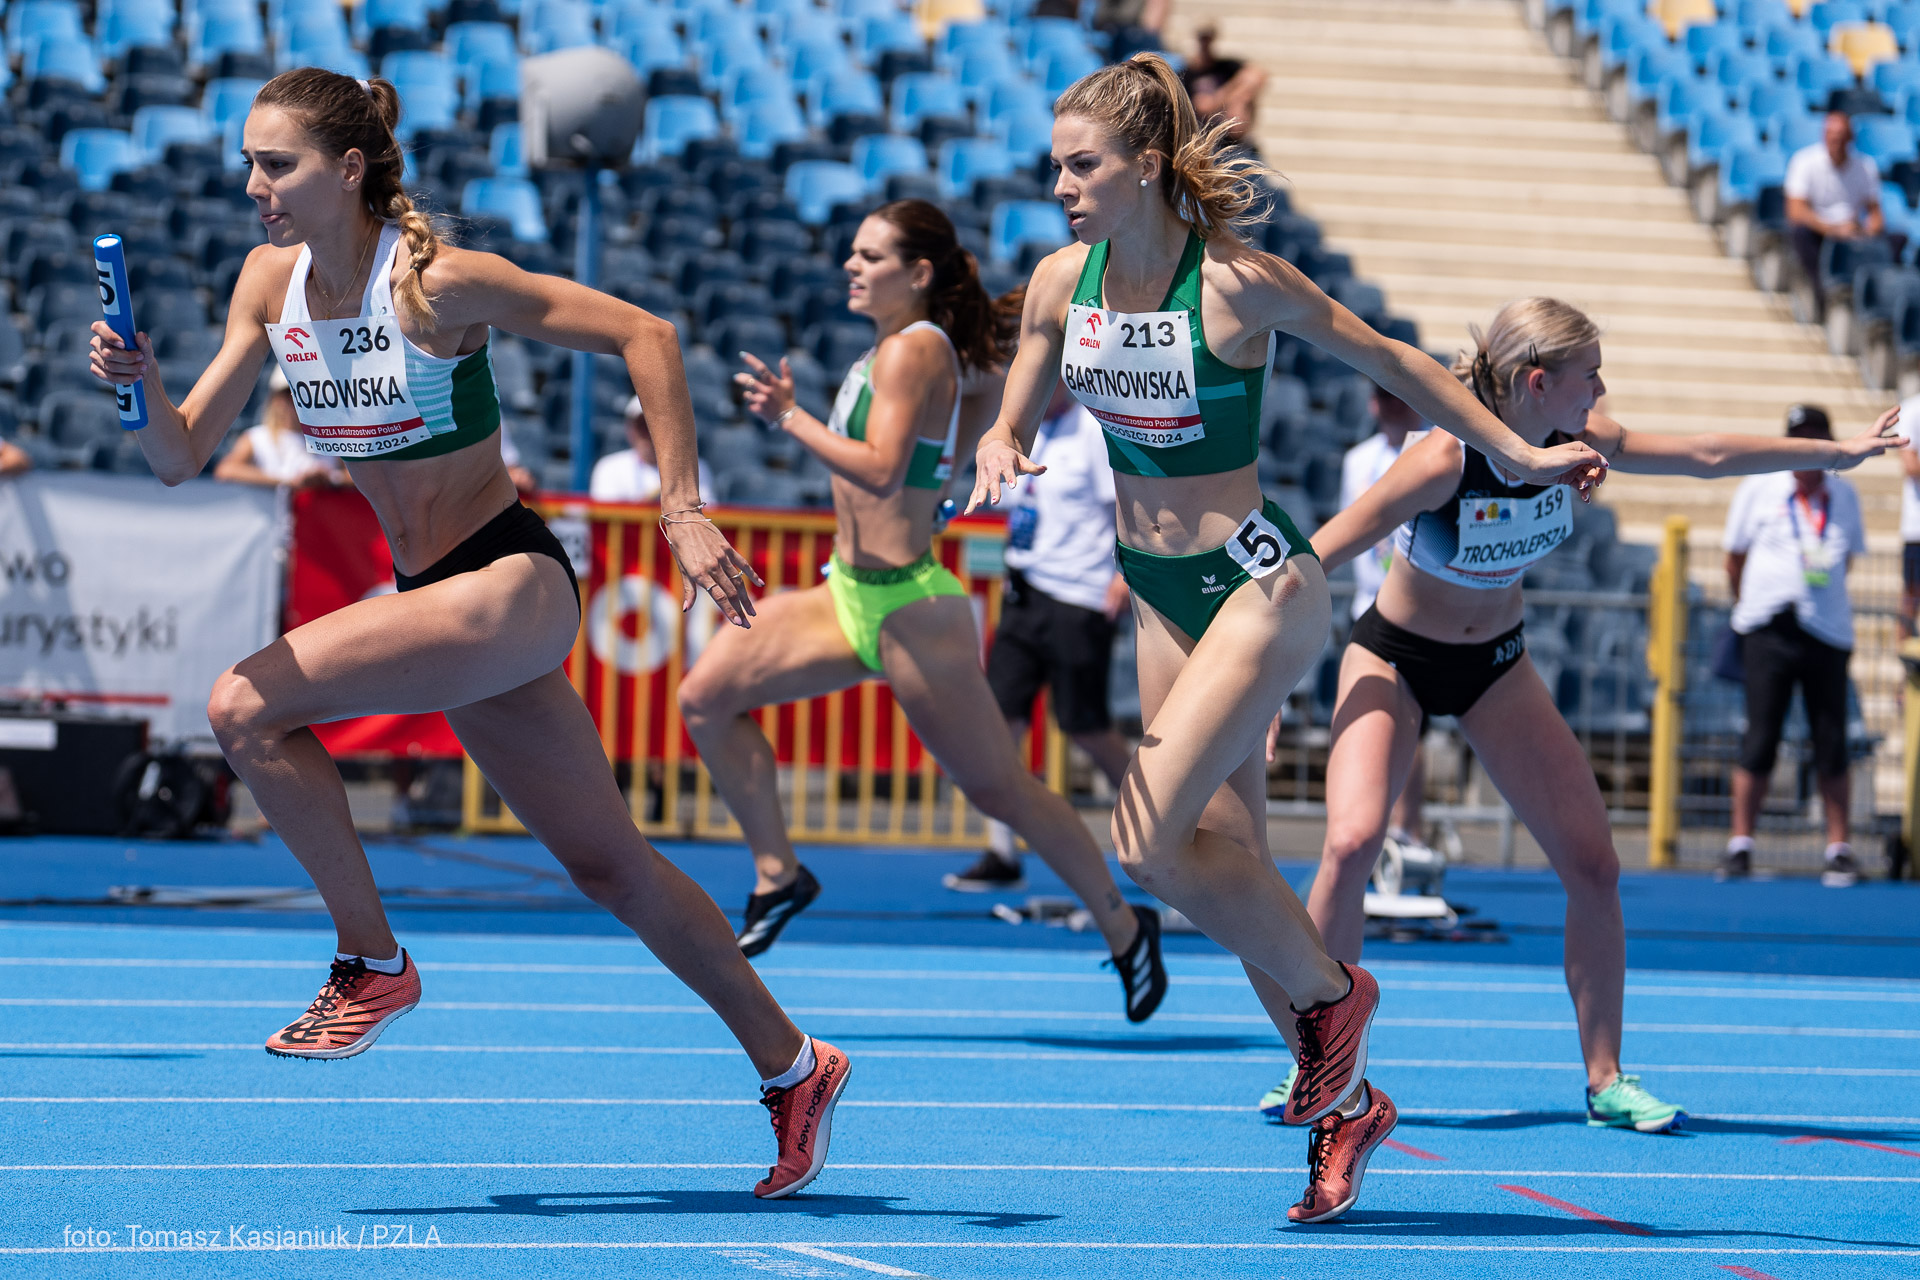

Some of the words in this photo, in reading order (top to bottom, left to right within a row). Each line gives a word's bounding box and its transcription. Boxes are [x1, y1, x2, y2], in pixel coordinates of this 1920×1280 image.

[339, 326, 390, 354] 236
[1079, 337, 1101, 349] ORLEN
[1120, 321, 1176, 348] 213
[285, 352, 318, 362] ORLEN
[1065, 363, 1190, 400] BARTNOWSKA
[321, 428, 338, 436] PZLA
[337, 427, 377, 436] Mistrzostwa
[377, 423, 402, 434] Polski
[1155, 418, 1179, 427] Polski
[315, 441, 375, 453] BYDGOSZCZ
[375, 435, 410, 451] 2024
[1150, 432, 1183, 444] 2024
[1533, 487, 1564, 520] 159
[1236, 519, 1282, 568] 5
[1462, 525, 1568, 564] TROCHOLEPSZA
[797, 1120, 812, 1153] new
[806, 1054, 839, 1118] balance
[1342, 1153, 1356, 1183] new
[1355, 1101, 1389, 1153] balance
